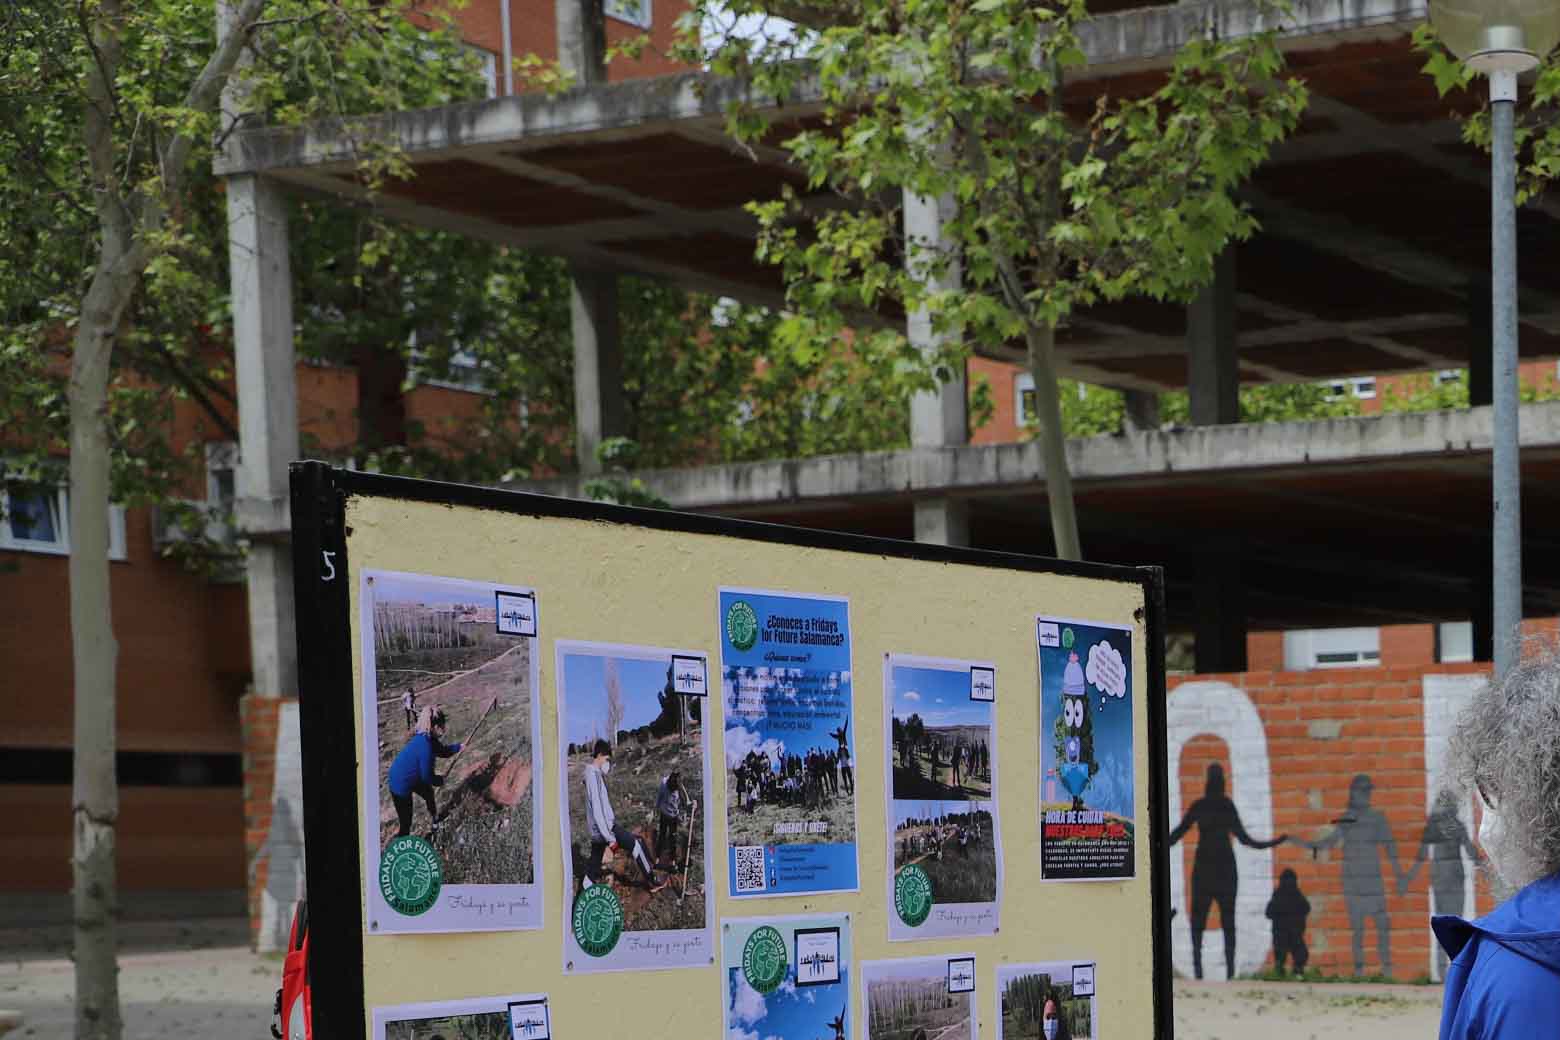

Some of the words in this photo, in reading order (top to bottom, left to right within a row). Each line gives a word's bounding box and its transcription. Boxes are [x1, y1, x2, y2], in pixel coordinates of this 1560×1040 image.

[322, 550, 336, 581] 5
[767, 615, 803, 630] ¿Conoces
[805, 620, 810, 631] a
[811, 617, 838, 633] Fridays
[774, 629, 798, 645] Future
[799, 631, 845, 647] Salamanca?
[1045, 811, 1066, 824] HORA
[1066, 811, 1077, 824] DE
[1077, 810, 1105, 824] CUIDAR
[381, 853, 396, 902] FRIDAYS
[393, 839, 413, 852] FOR
[415, 840, 440, 878] FUTURE
[895, 879, 904, 916] FRIDAYS
[902, 866, 914, 877] FOR
[914, 867, 931, 896] FUTURE
[574, 900, 586, 945] FRIDAYS
[584, 888, 601, 901] FOR
[602, 888, 621, 922] FUTURE
[744, 941, 756, 984] FRIDAYS
[753, 929, 768, 941] FOR
[768, 929, 786, 961] FUTURE
